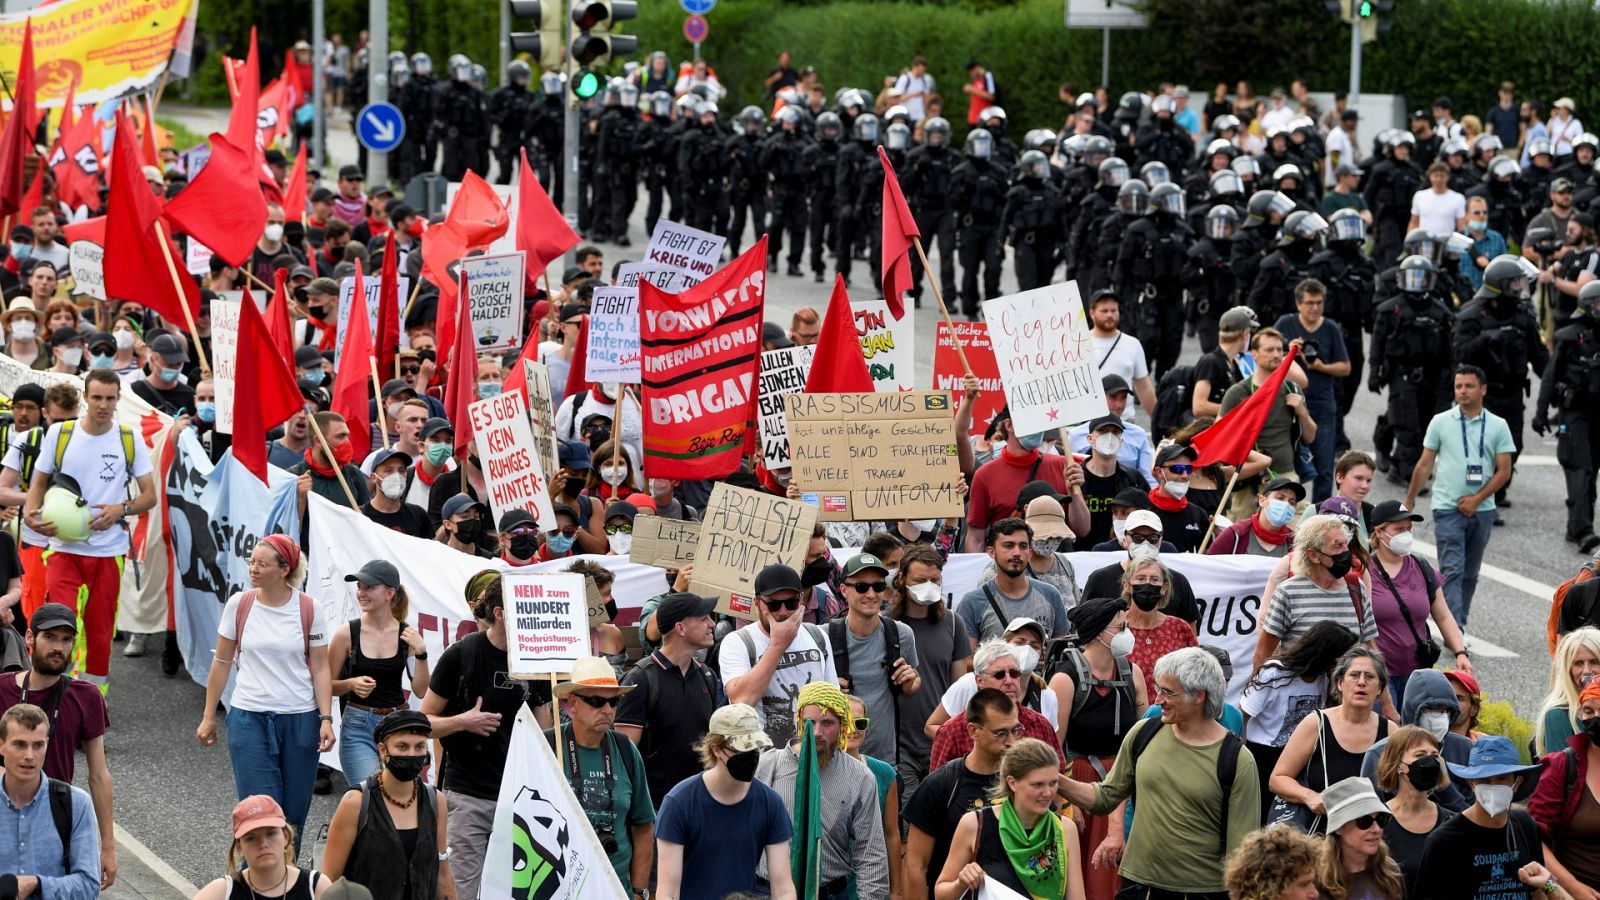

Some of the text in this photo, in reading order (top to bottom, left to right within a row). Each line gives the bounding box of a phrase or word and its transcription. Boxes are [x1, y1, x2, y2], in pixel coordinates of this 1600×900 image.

[658, 229, 717, 257] FIGHT G7
[650, 248, 714, 275] KRIEG UND
[657, 271, 676, 288] G7
[471, 281, 510, 296] OIFACH
[472, 306, 511, 322] HALDE!
[594, 296, 635, 315] FIGHT
[590, 316, 624, 332] Hoch
[854, 310, 887, 336] JIN
[1001, 311, 1074, 353] Gegen
[1009, 332, 1089, 375] macht
[471, 393, 520, 432] ES GIBT
[764, 416, 786, 437] ALLE
[822, 423, 881, 440] unzählige
[486, 425, 515, 454] KEIN
[796, 445, 831, 460] ALLE
[849, 446, 878, 458] SIND
[488, 448, 531, 481] RUHIGES
[864, 469, 906, 480] TRAGEN
[711, 489, 802, 553] ABOLISH
[513, 584, 570, 598] NEIN zum
[515, 601, 570, 615] HUNDERT
[516, 616, 572, 630] Milliarden
[518, 634, 581, 644] Hochrüstungs-
[518, 643, 567, 654] Programm
